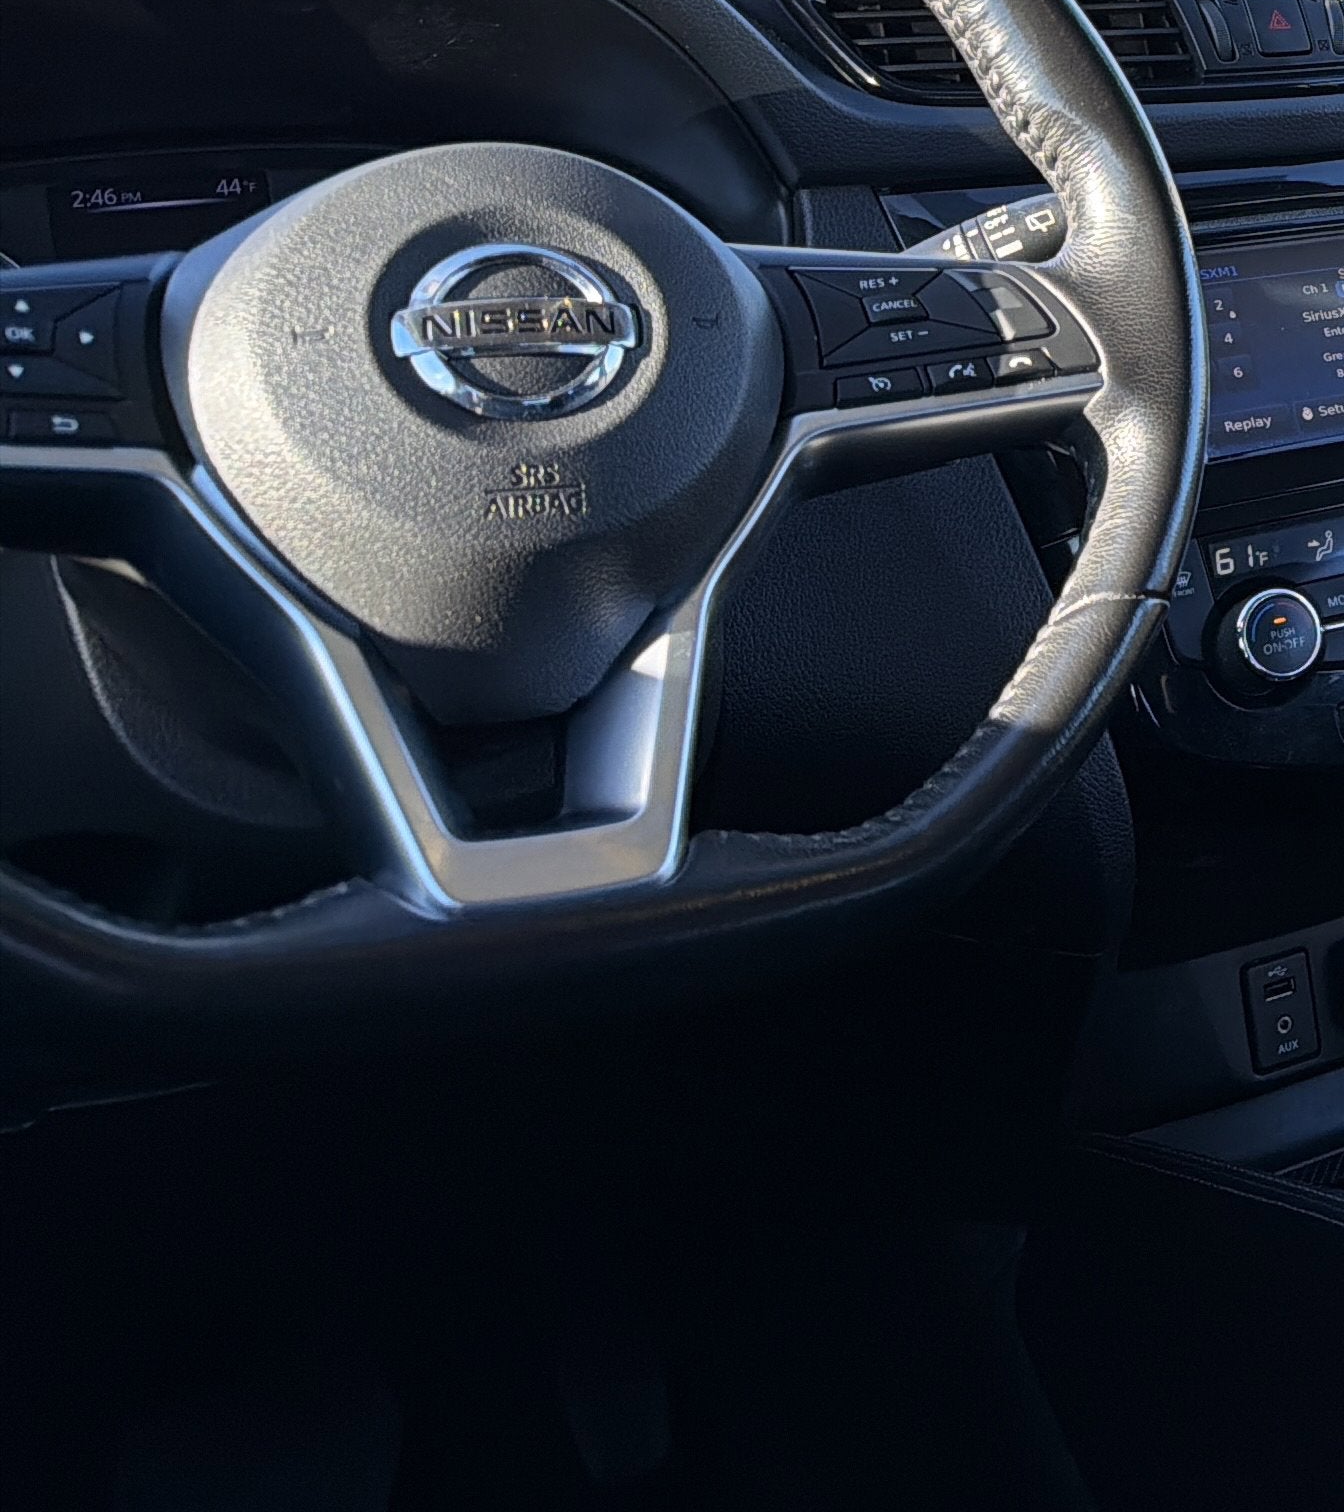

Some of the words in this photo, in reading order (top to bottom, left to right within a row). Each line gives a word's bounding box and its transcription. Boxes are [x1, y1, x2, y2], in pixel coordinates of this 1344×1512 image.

[71, 188, 117, 208] 2:46
[121, 191, 142, 203] PM
[1199, 264, 1239, 281] SXM1
[859, 277, 884, 290] RES
[1303, 284, 1319, 296] Ch
[1320, 283, 1329, 294] 1
[872, 299, 918, 312] CANCEL
[1214, 299, 1223, 311] 2
[421, 307, 616, 341] NISSAN
[4, 326, 35, 343] OK
[890, 330, 912, 342] SET
[1224, 333, 1234, 345] 4
[1233, 366, 1243, 378] 6
[1224, 415, 1272, 433] Replay
[511, 462, 560, 487] SRS
[1270, 627, 1295, 639] PUSH
[1278, 1039, 1299, 1054] AUX
